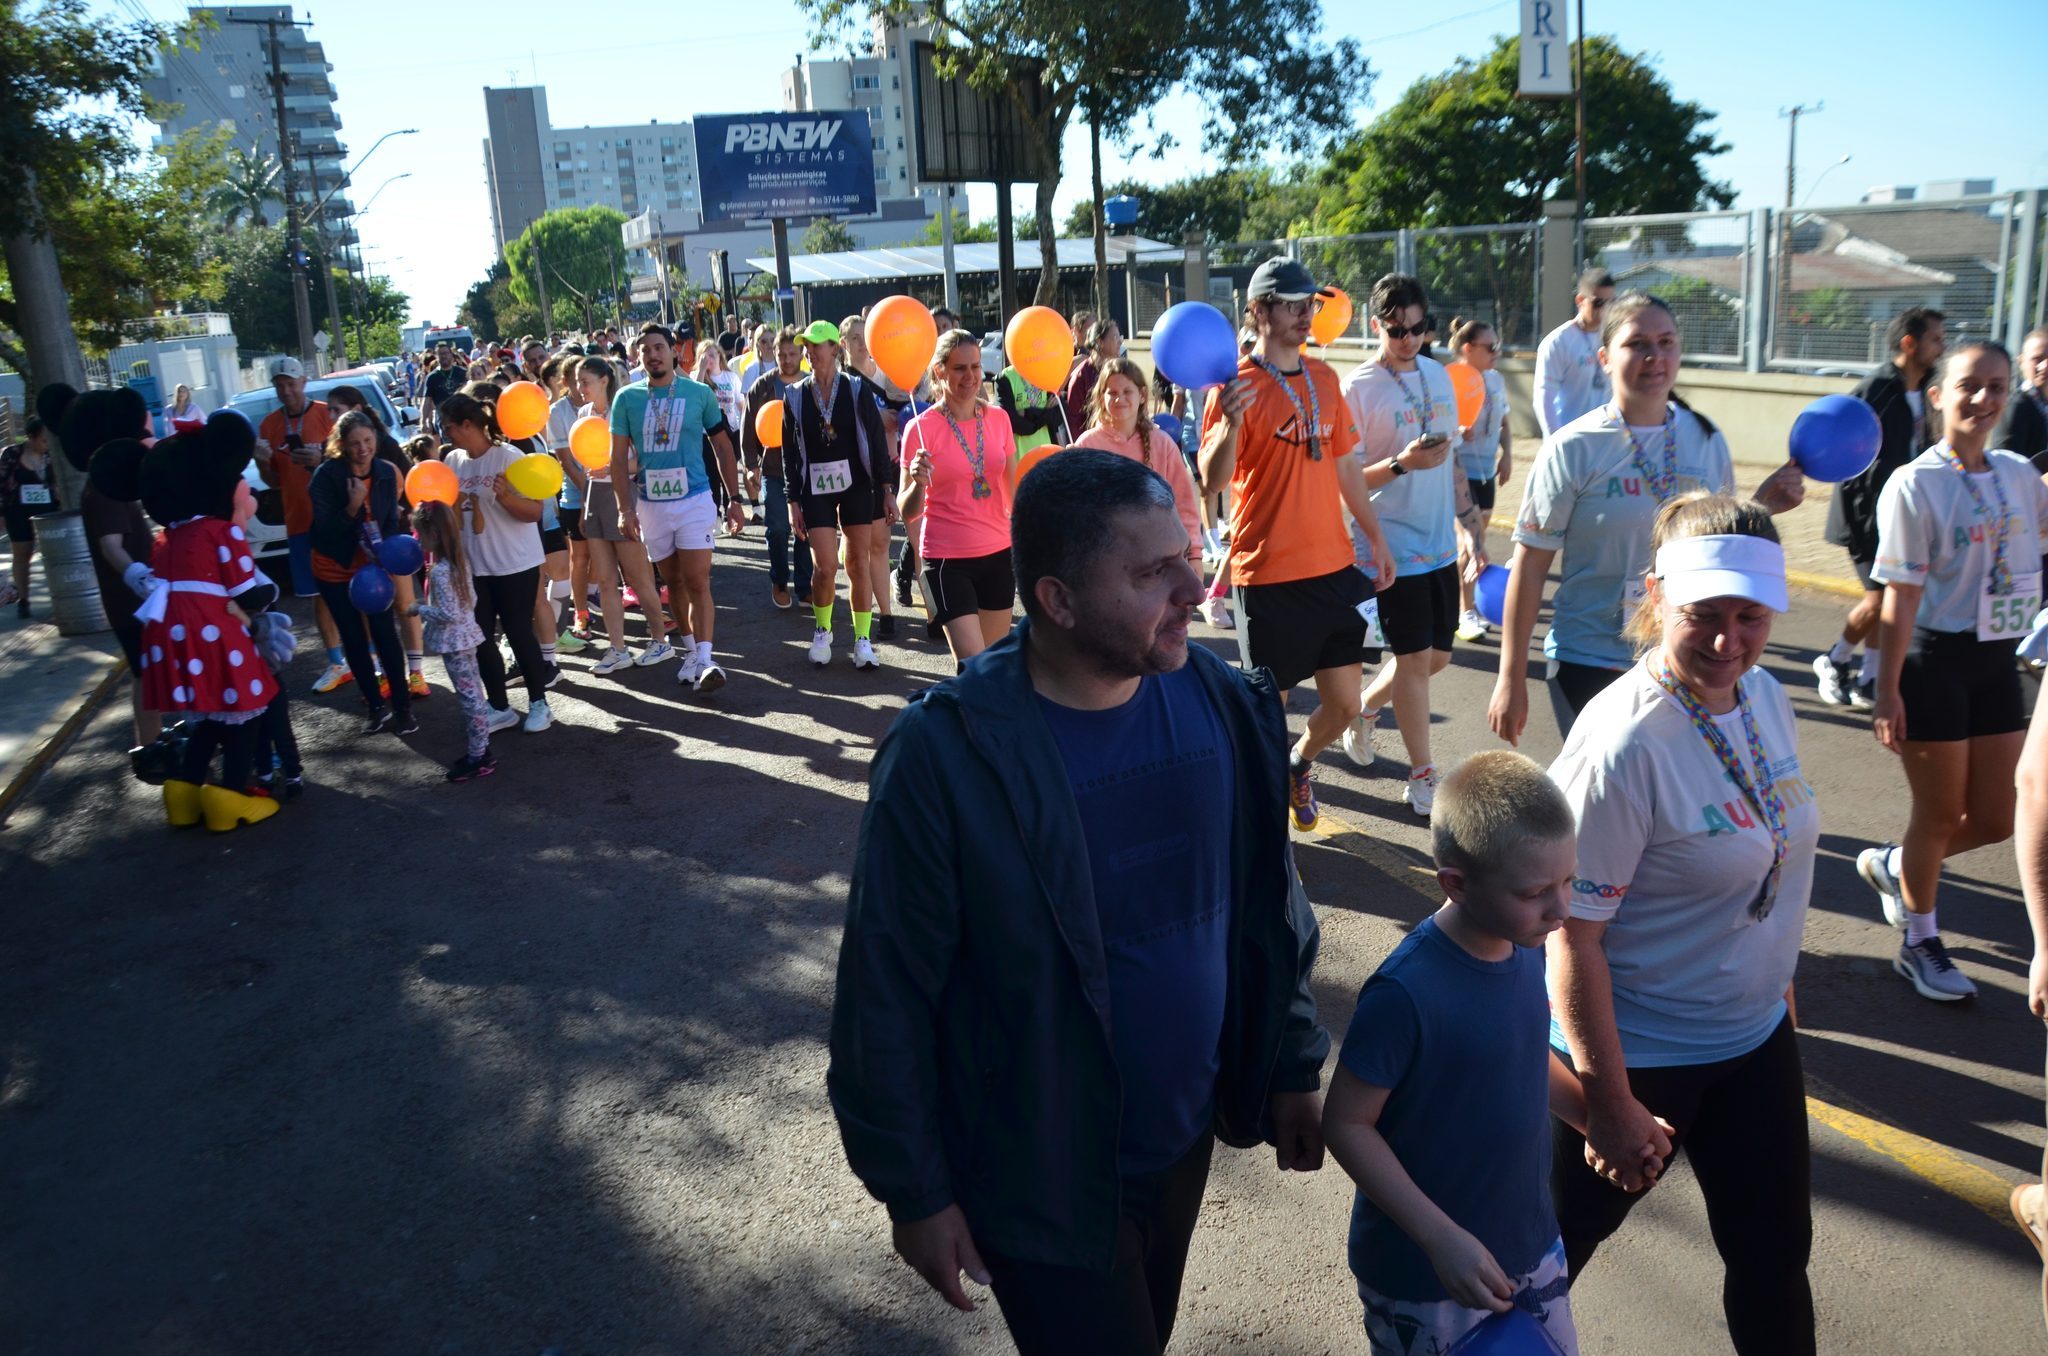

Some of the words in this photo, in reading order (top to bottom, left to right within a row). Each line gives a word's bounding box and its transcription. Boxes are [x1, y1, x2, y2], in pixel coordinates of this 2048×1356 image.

[724, 120, 843, 154] PBNEW
[754, 150, 845, 165] SISTEMAS
[748, 171, 780, 183] Soluções
[781, 169, 827, 180] tecnológicas
[761, 179, 792, 191] produtos
[651, 479, 683, 497] 444
[816, 472, 845, 490] 411
